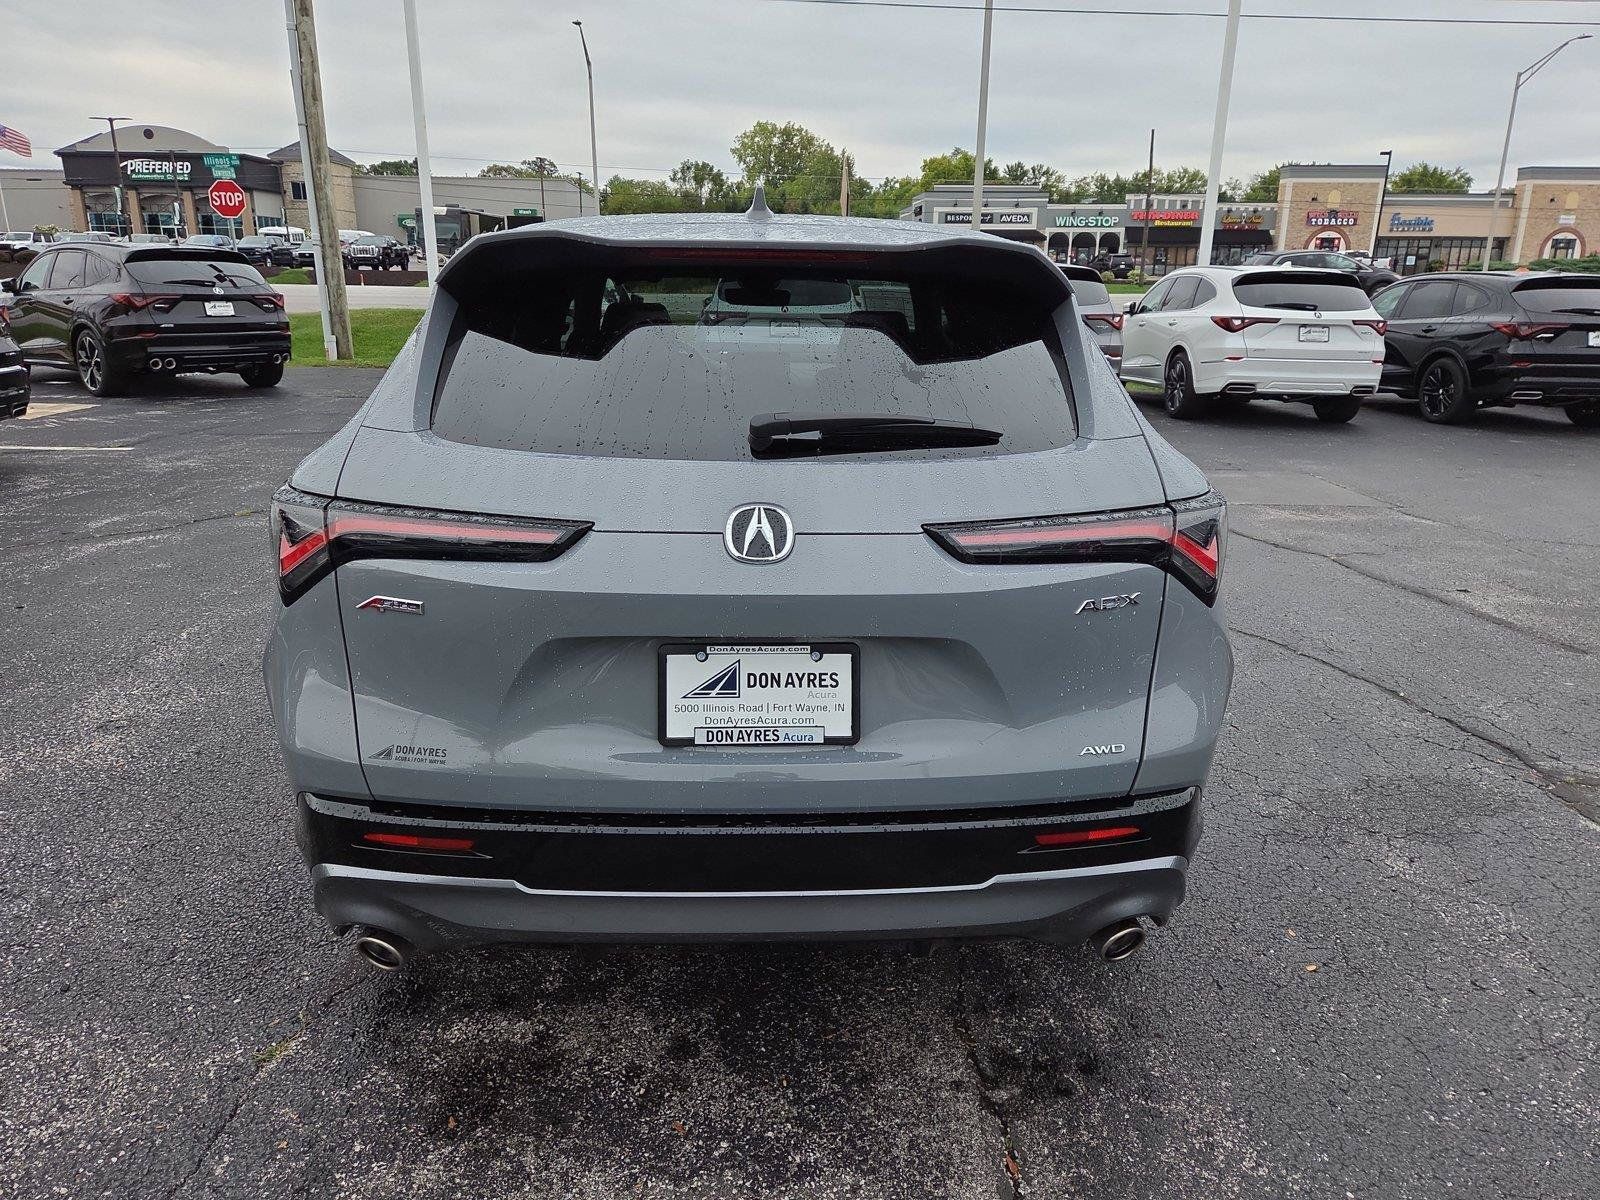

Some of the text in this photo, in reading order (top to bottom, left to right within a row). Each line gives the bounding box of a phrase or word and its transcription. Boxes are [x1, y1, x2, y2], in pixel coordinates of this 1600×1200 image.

[203, 155, 230, 165] Illinois
[212, 191, 243, 207] STOP
[1000, 214, 1029, 222] AVEDA
[1154, 219, 1193, 227] Restaurant
[709, 645, 809, 654] DonAyresAcura.com
[747, 671, 840, 689] DON AYRES
[807, 690, 837, 699] Acura
[674, 703, 700, 713] 5000
[703, 703, 735, 713] Illinois
[738, 703, 764, 713] Road
[773, 703, 793, 712] Fort
[795, 703, 831, 714] Wayne,
[834, 703, 845, 712] IN
[704, 716, 815, 727] DonAyresAcura.com
[706, 729, 814, 743] DON AYRES Acura
[395, 745, 447, 758] DON AYRES
[1079, 743, 1126, 756] AWD
